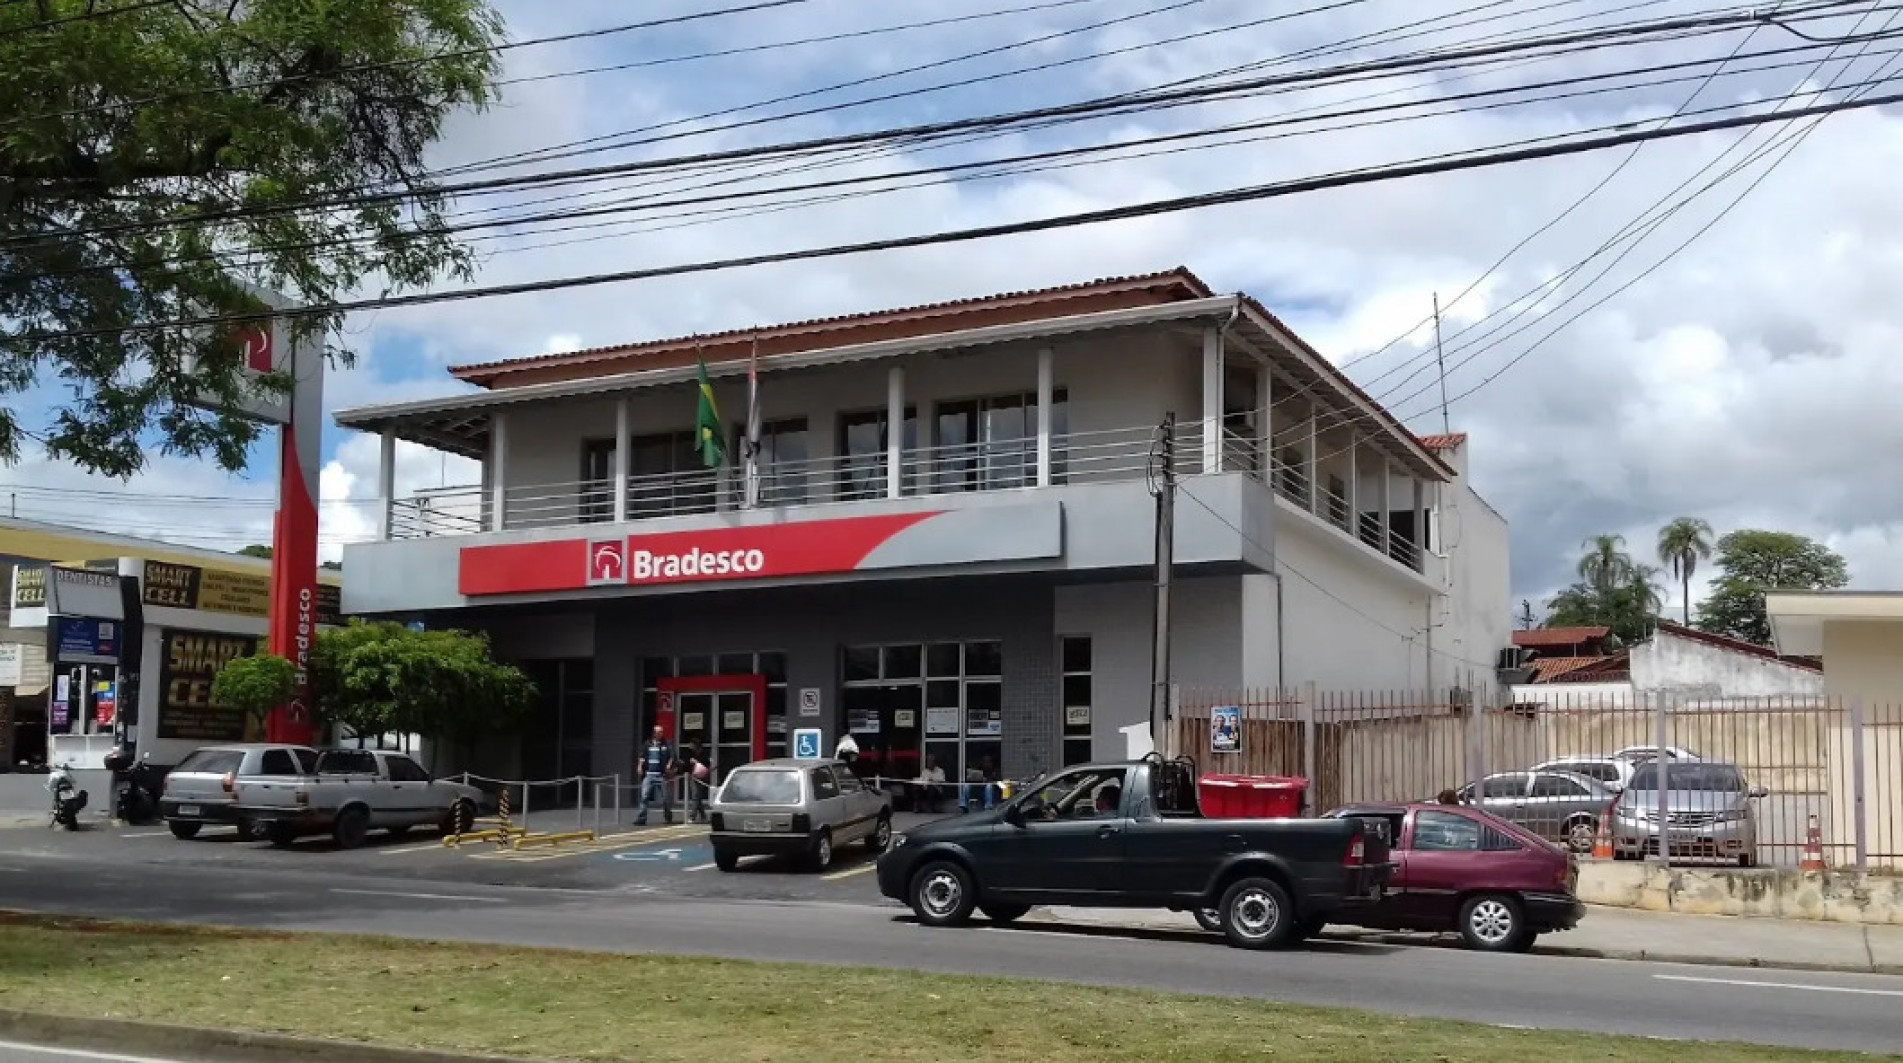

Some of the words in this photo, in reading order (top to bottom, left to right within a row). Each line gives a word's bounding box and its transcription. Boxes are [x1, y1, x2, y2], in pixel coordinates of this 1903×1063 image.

[633, 547, 765, 579] Bradesco
[57, 571, 112, 587] DENTISTAS
[146, 564, 193, 588] SMART
[17, 588, 46, 603] CELL
[144, 587, 190, 606] CELL
[294, 588, 311, 685] Bradesco
